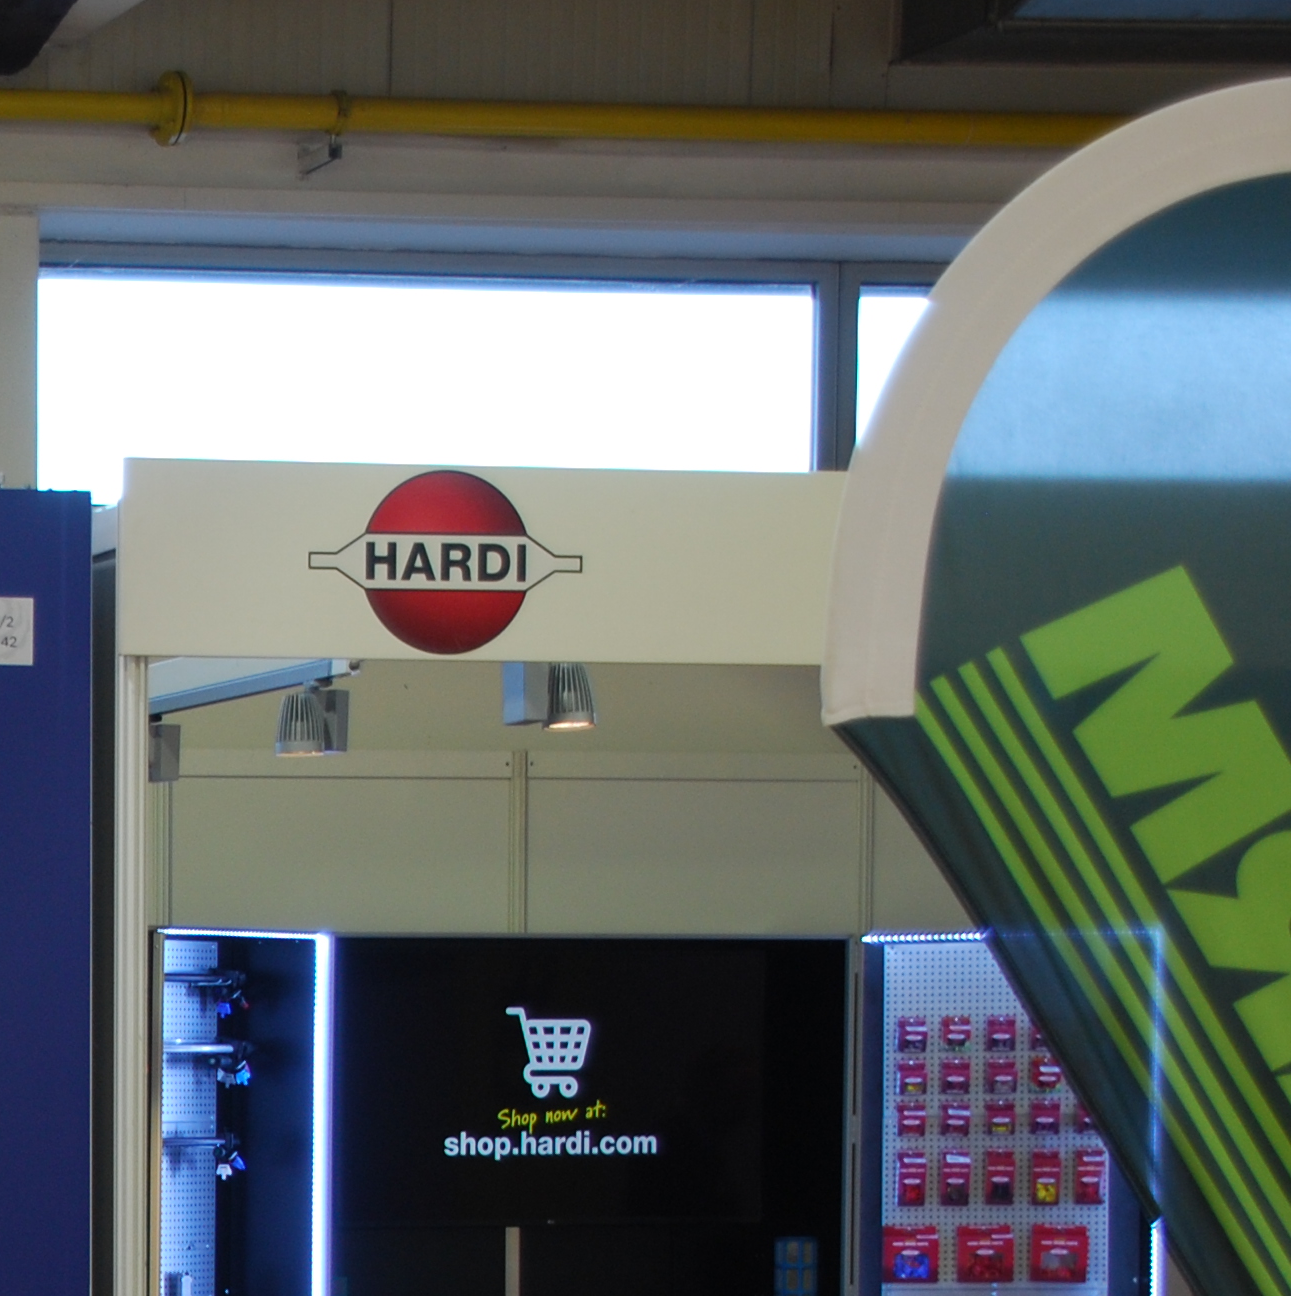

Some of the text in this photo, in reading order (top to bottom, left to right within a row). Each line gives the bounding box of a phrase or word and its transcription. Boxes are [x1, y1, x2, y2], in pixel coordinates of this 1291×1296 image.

[364, 541, 528, 584] HARDI
[0, 636, 18, 648] 42
[497, 1099, 606, 1135] Shop now at:
[444, 1129, 658, 1161] shop.hardi.com
